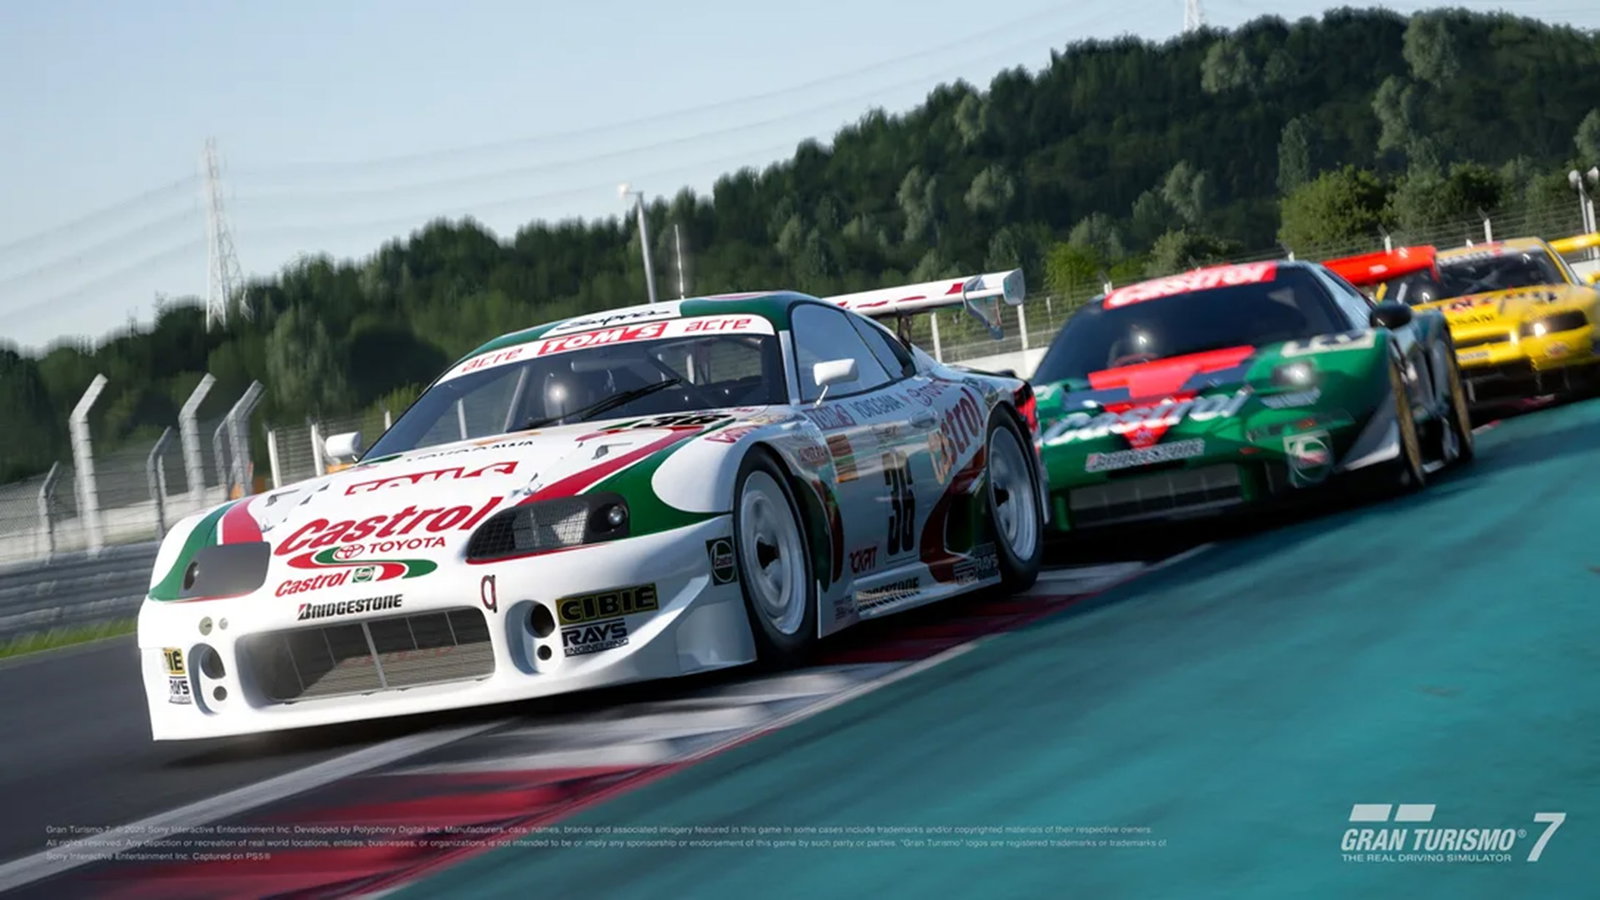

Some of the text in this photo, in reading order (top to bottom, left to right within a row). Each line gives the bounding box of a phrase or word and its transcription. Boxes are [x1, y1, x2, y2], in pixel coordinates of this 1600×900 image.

[461, 318, 752, 373] acre TOM'S acre
[928, 387, 985, 484] Castrol
[1044, 384, 1255, 446] Castrol
[882, 452, 915, 556] 36
[274, 497, 504, 556] Castrol
[369, 536, 447, 554] TOYOTA
[274, 569, 352, 598] Castrol
[560, 587, 655, 621] CIBIE
[297, 594, 403, 621] BRIDGESTONE
[561, 622, 628, 647] RAYS
